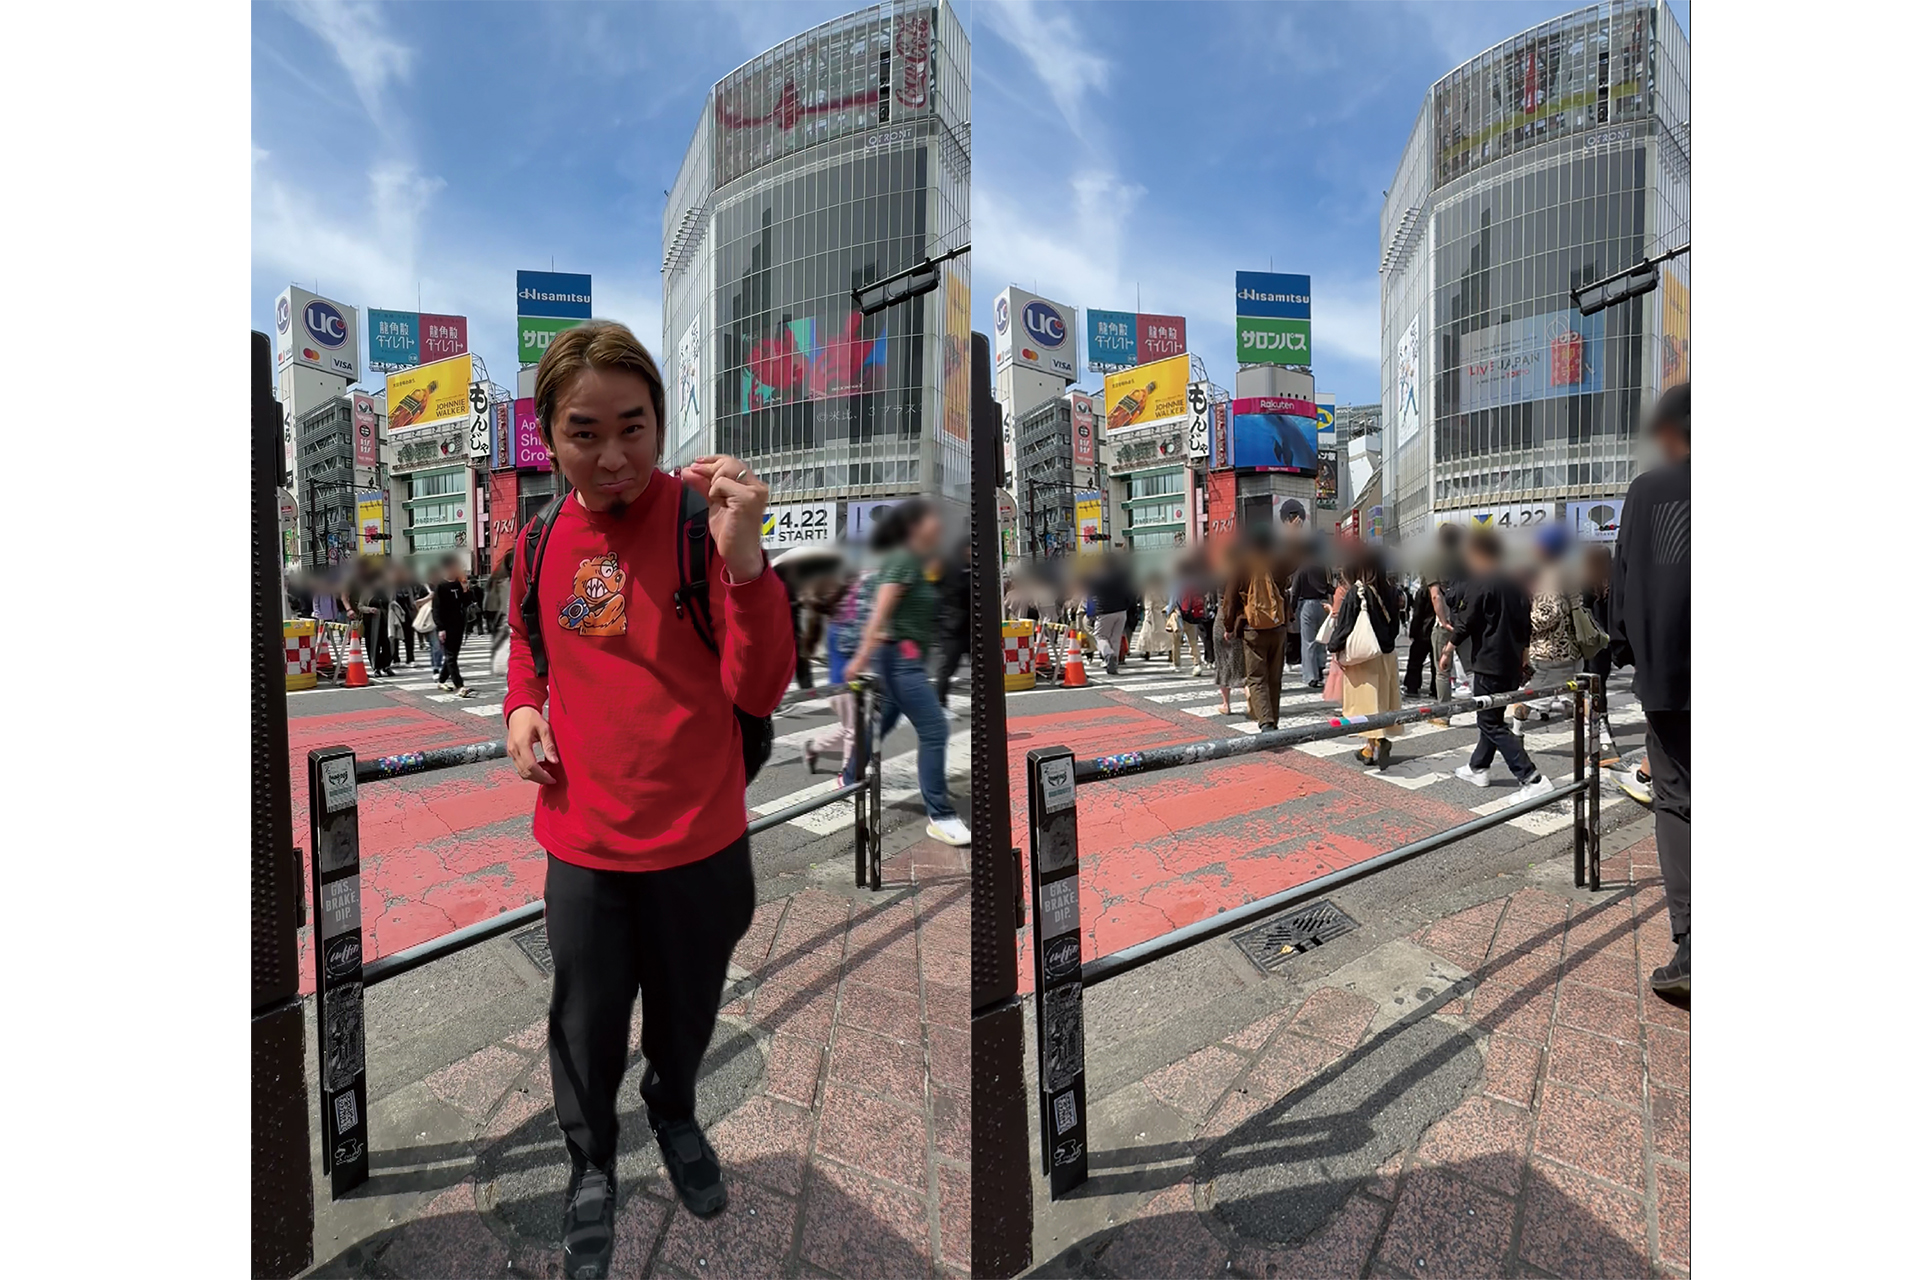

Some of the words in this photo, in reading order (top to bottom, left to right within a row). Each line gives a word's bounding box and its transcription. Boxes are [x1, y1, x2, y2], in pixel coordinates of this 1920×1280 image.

[518, 287, 591, 304] Hisamitsu
[1237, 288, 1310, 304] Hisamitsu
[307, 308, 344, 339] UC
[379, 321, 409, 336] 龍角散
[1026, 308, 1064, 339] UC
[1098, 321, 1128, 337] 龍角散
[429, 325, 458, 340] 龍角散
[1241, 330, 1307, 351] サロンパス
[333, 357, 353, 371] VISA
[1052, 358, 1072, 371] VISA
[1498, 353, 1540, 371] JAPAN
[436, 399, 466, 411] JOHNNIE
[436, 406, 466, 417] WALKER
[1155, 399, 1185, 411] JOHNNIE
[1155, 407, 1185, 418] WALKER
[1260, 399, 1295, 410] Rakuten
[469, 382, 489, 454] もんじゃ
[1188, 383, 1208, 454] もんじゃ
[778, 509, 828, 529] 4.22
[1499, 509, 1547, 528] 4.22
[778, 529, 828, 542] START!
[331, 880, 352, 896] GAS.
[1050, 881, 1072, 897] GAS.
[325, 891, 359, 912] BRAKE.
[1044, 892, 1078, 913] BRAKE.
[335, 906, 352, 922] DIP.
[1054, 907, 1071, 923] DIP.
